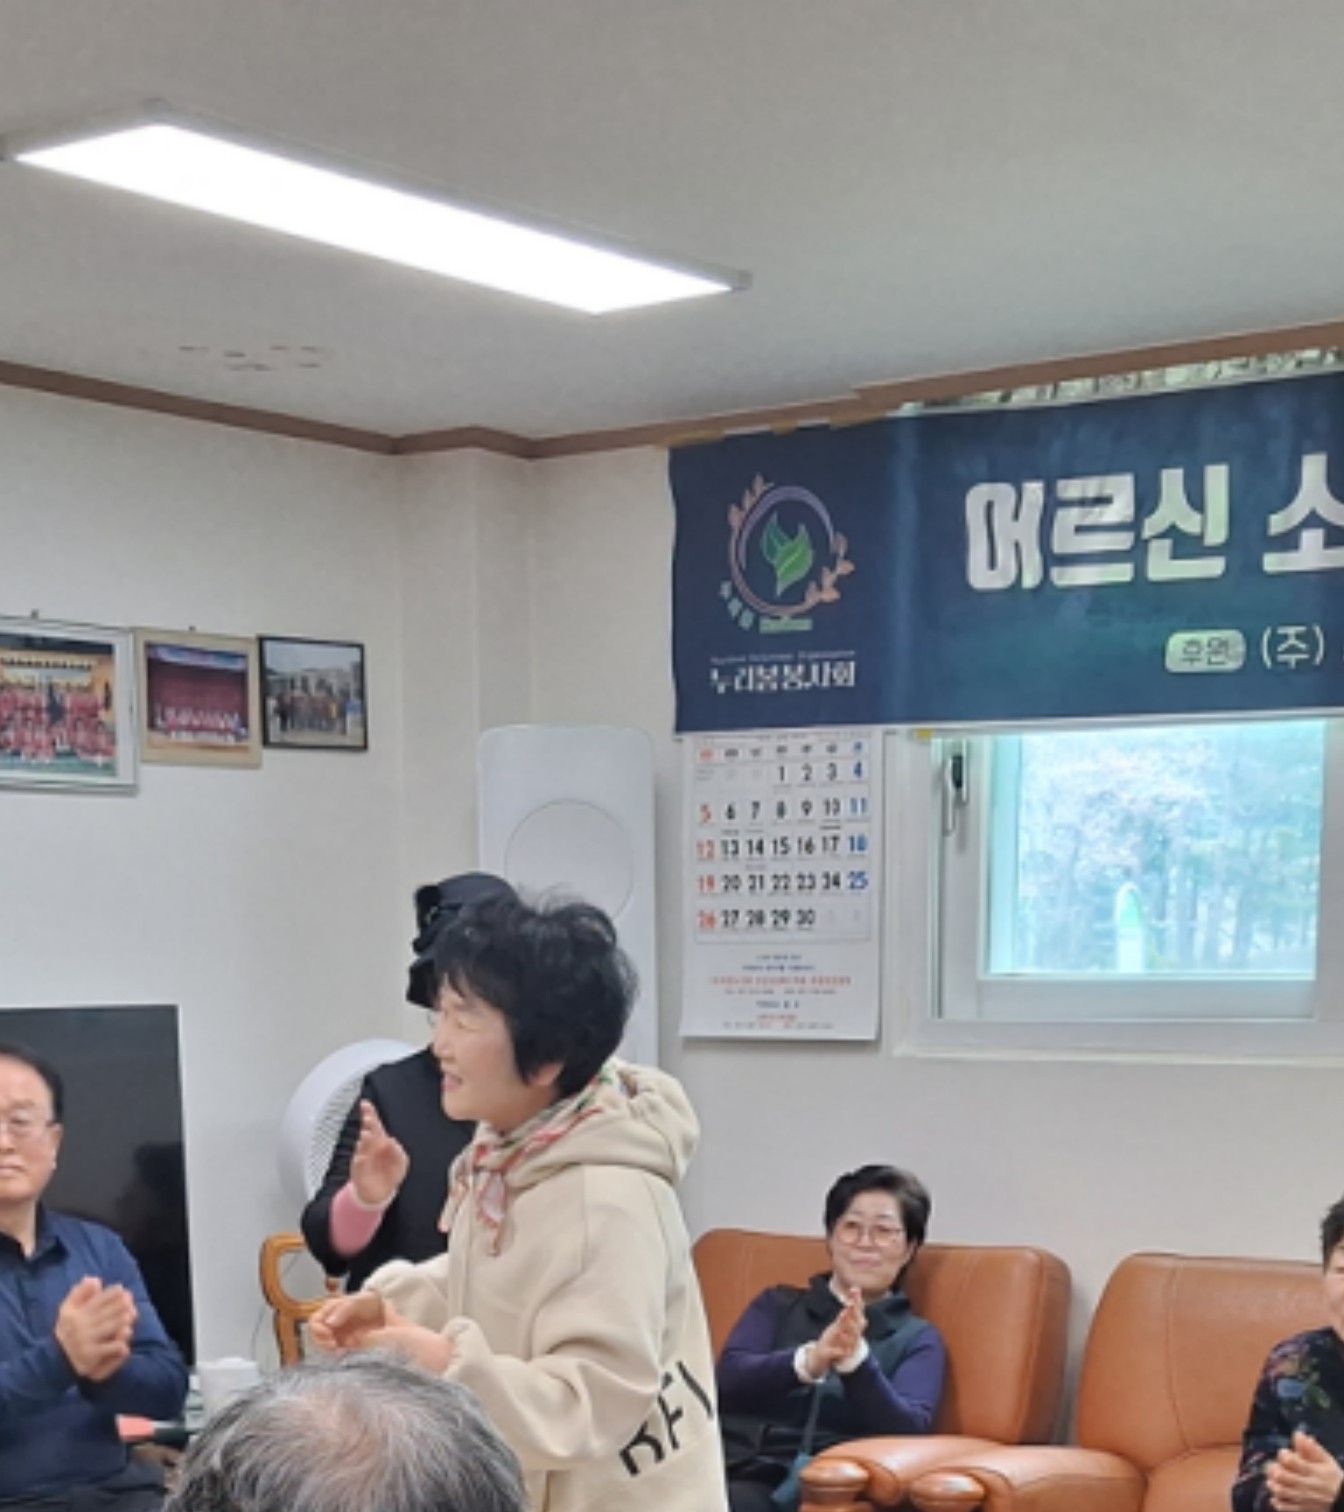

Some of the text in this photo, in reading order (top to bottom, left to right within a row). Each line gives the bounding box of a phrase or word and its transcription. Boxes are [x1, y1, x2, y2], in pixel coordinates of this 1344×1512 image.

[965, 463, 1230, 591] 어르신
[1181, 636, 1232, 667] 후원
[1262, 622, 1325, 670] (주)
[778, 765, 786, 781] 1
[801, 763, 813, 782] 2
[853, 760, 862, 778] 4
[725, 803, 736, 820] 6
[751, 801, 761, 819] 7
[801, 799, 812, 816] 9
[721, 839, 739, 855] 13
[747, 838, 764, 855] 14
[772, 836, 790, 855] 15
[797, 836, 815, 855] 16
[822, 835, 840, 852] 17
[722, 874, 741, 892] 20
[771, 874, 791, 890] 22
[796, 873, 816, 890] 23
[847, 871, 868, 890] 25
[722, 909, 740, 928] 27
[748, 909, 766, 928] 28
[771, 908, 791, 928] 29
[796, 909, 816, 926] 30
